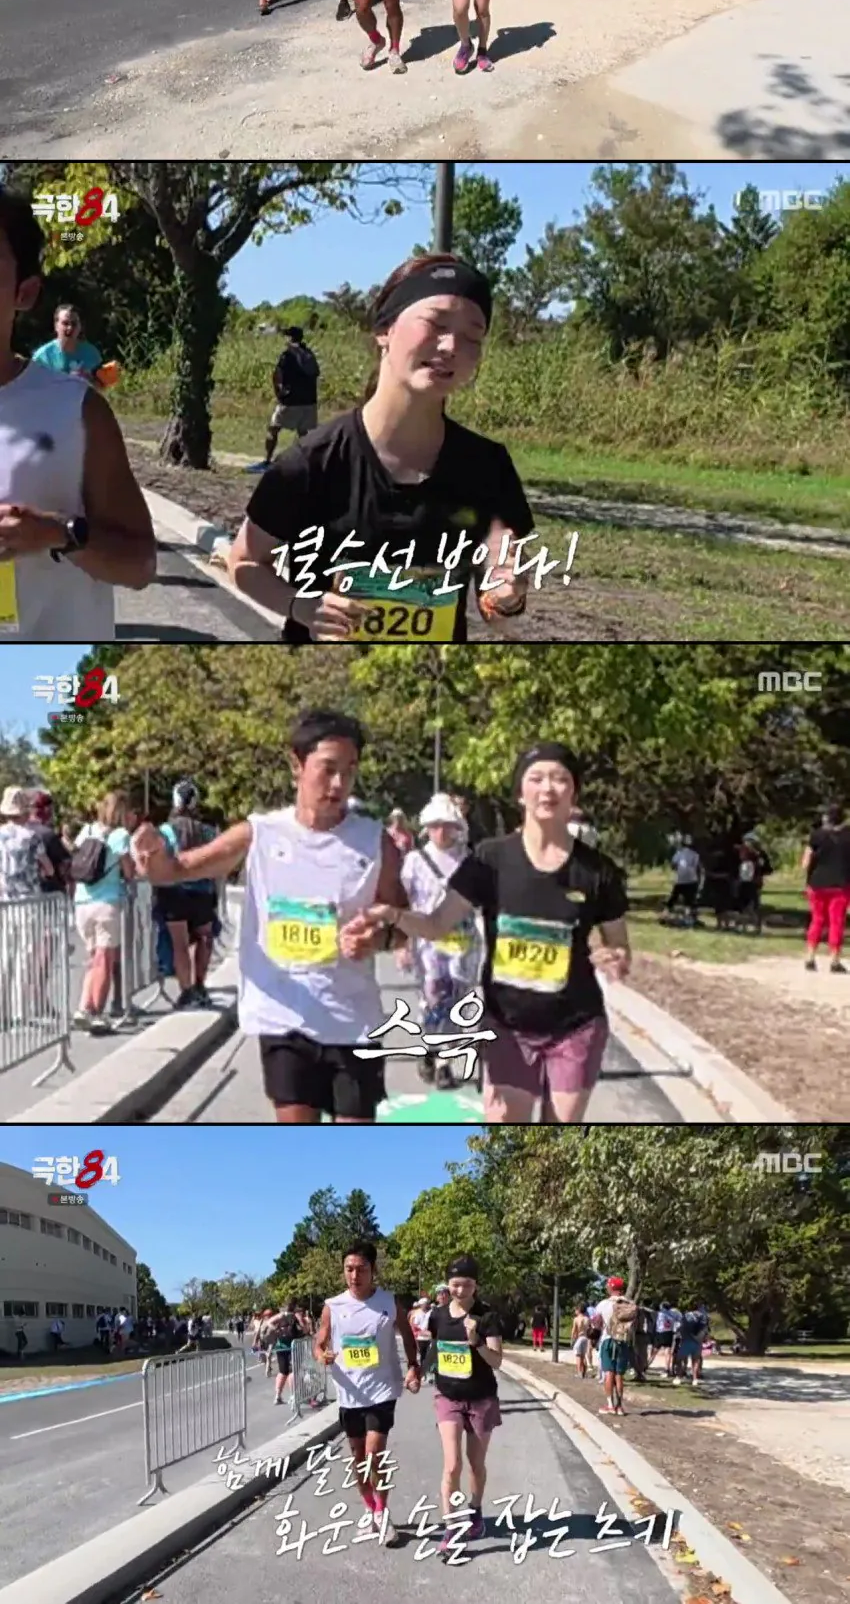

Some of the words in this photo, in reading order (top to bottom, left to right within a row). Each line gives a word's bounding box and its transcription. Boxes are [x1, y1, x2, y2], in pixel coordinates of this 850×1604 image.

[362, 606, 434, 637] 820
[281, 924, 322, 946] 1816
[507, 941, 559, 965] 1820
[349, 1349, 371, 1359] 1816
[443, 1354, 466, 1365] 1820
